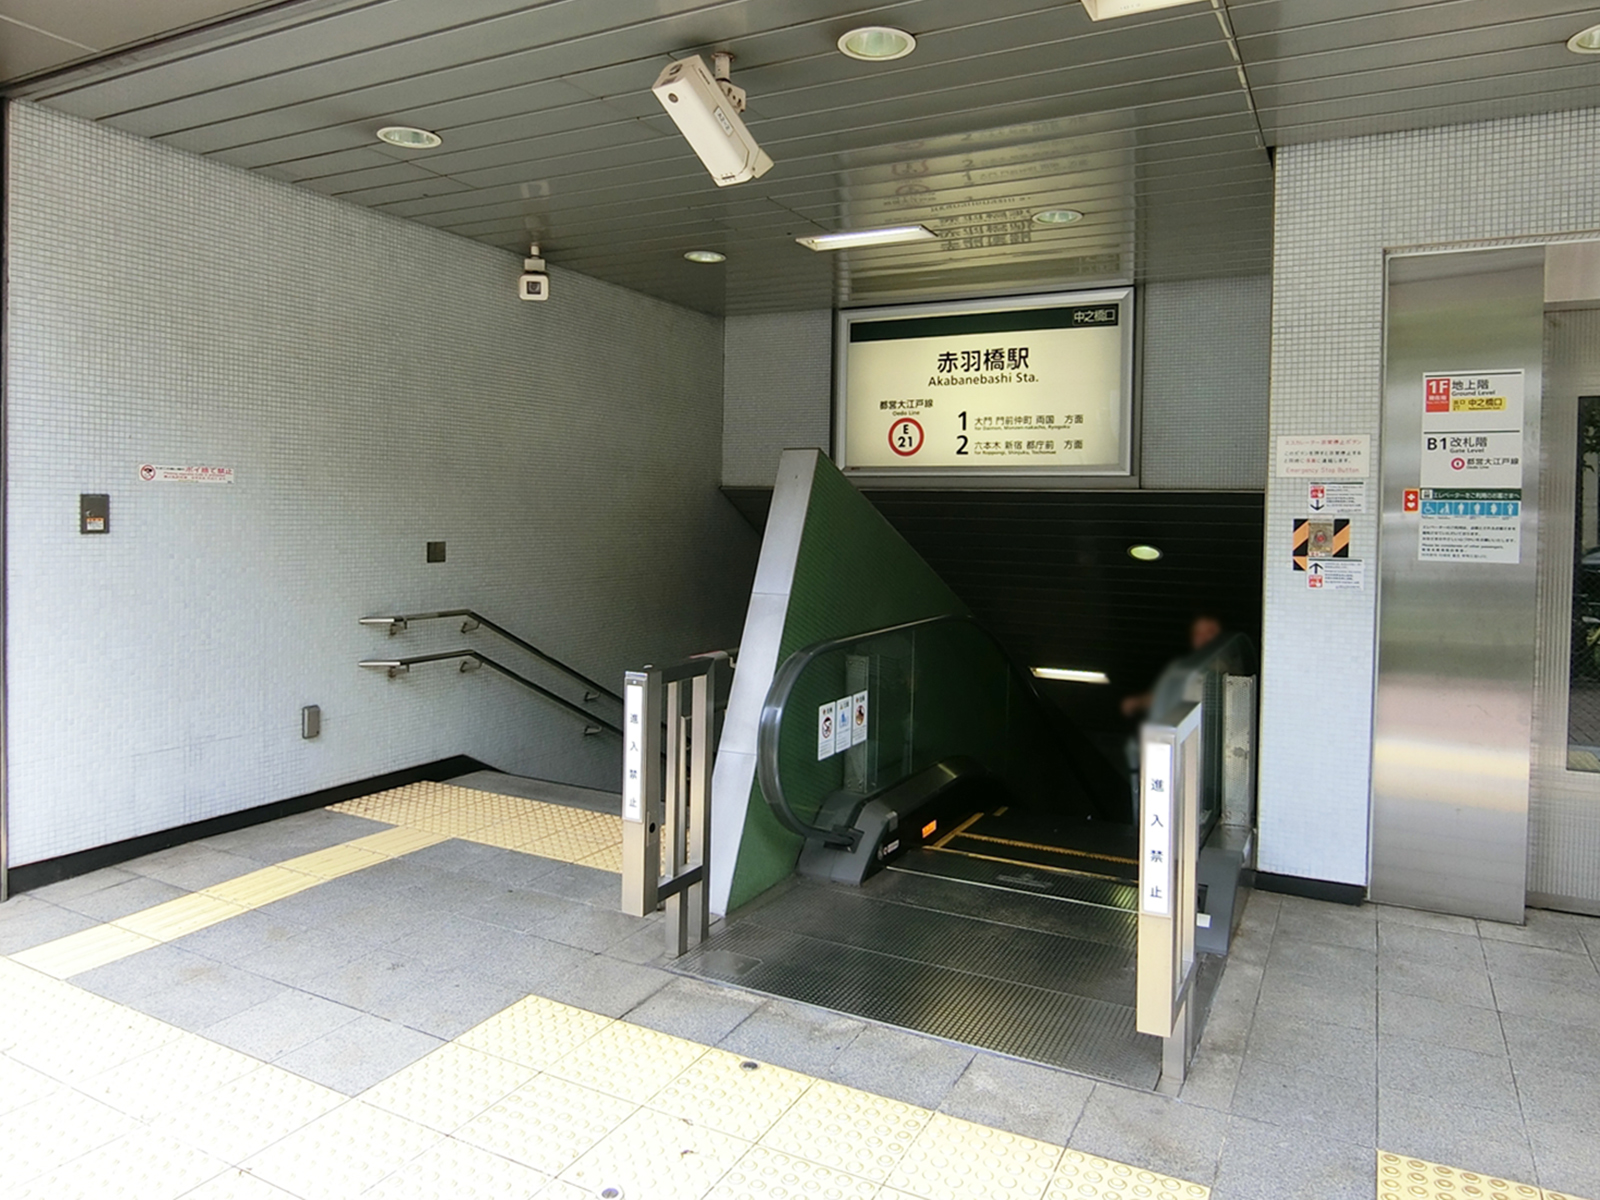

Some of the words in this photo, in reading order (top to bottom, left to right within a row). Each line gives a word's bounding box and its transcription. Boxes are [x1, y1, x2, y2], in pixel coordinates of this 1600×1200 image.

[1074, 309, 1115, 323] 中之橋口
[937, 347, 1029, 373] 赤羽橋駅
[928, 373, 1012, 386] Akabanebashi
[1016, 372, 1039, 383] Sta.
[1452, 379, 1489, 390] 地上階
[1429, 381, 1449, 394] 1F
[880, 399, 933, 410] 都営大江戸線
[1468, 398, 1502, 407] 中之橋口
[958, 411, 967, 431] 1
[975, 417, 992, 426] 大門
[995, 416, 1032, 425] 門前仲町
[1036, 415, 1054, 424] 両国
[1064, 414, 1083, 424] 方面
[903, 424, 909, 434] E
[898, 436, 912, 448] 21
[956, 435, 968, 455] 2
[974, 441, 1001, 450] 六本木
[1005, 441, 1022, 450] 新宿
[1026, 440, 1054, 450] 都庁前
[1064, 440, 1083, 450] 方面
[1427, 437, 1447, 450] B1
[1450, 437, 1487, 447] 改札階
[629, 713, 639, 808] 進入禁止
[1150, 778, 1165, 899] 進入禁止
